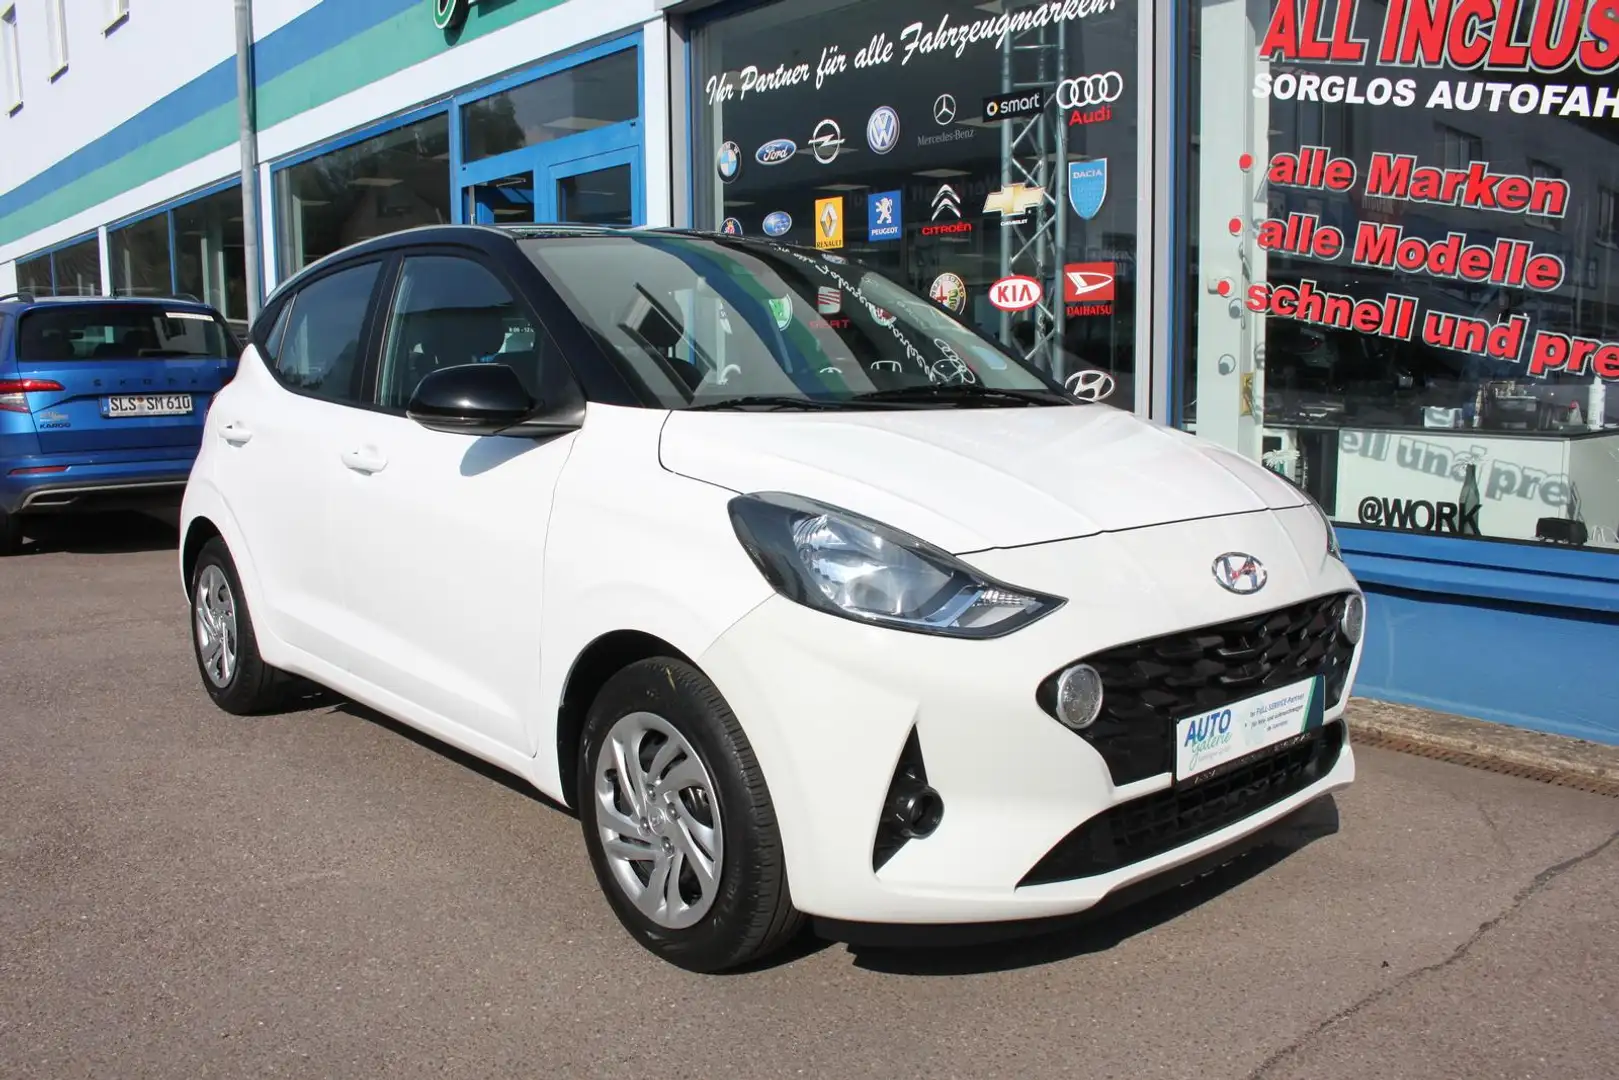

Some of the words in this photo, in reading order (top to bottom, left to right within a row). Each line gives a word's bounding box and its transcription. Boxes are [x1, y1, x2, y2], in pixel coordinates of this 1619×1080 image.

[1259, 0, 1369, 66] ALL
[1376, 0, 1619, 75] INCLUS
[706, 73, 734, 105] Ihr
[740, 65, 810, 100] Partner
[815, 45, 847, 90] für
[854, 32, 893, 69] alle
[1000, 93, 1040, 114] smart
[1252, 73, 1416, 109] SORGLOS
[1425, 80, 1619, 118] AUTOFAH
[1068, 105, 1112, 126] Audi
[917, 129, 974, 147] Mercedes-Benz
[763, 144, 788, 162] Ford
[1072, 169, 1103, 179] DACIA
[1268, 145, 1356, 192] alle
[1365, 152, 1570, 218] Marken
[871, 226, 898, 236] PEUGEOT
[816, 239, 842, 248] RENAULT
[1257, 212, 1344, 260] alle
[1352, 221, 1565, 292] Modelle
[997, 283, 1033, 303] KIA
[1066, 305, 1112, 317] DAIHATSU
[1245, 279, 1419, 341] schnell
[1423, 310, 1530, 363] und
[1526, 330, 1619, 382] pre
[111, 396, 137, 412] SLS
[147, 396, 164, 411] SM
[166, 395, 191, 409] 610
[1358, 495, 1483, 537] @WORK
[1184, 708, 1232, 748] AUTO
